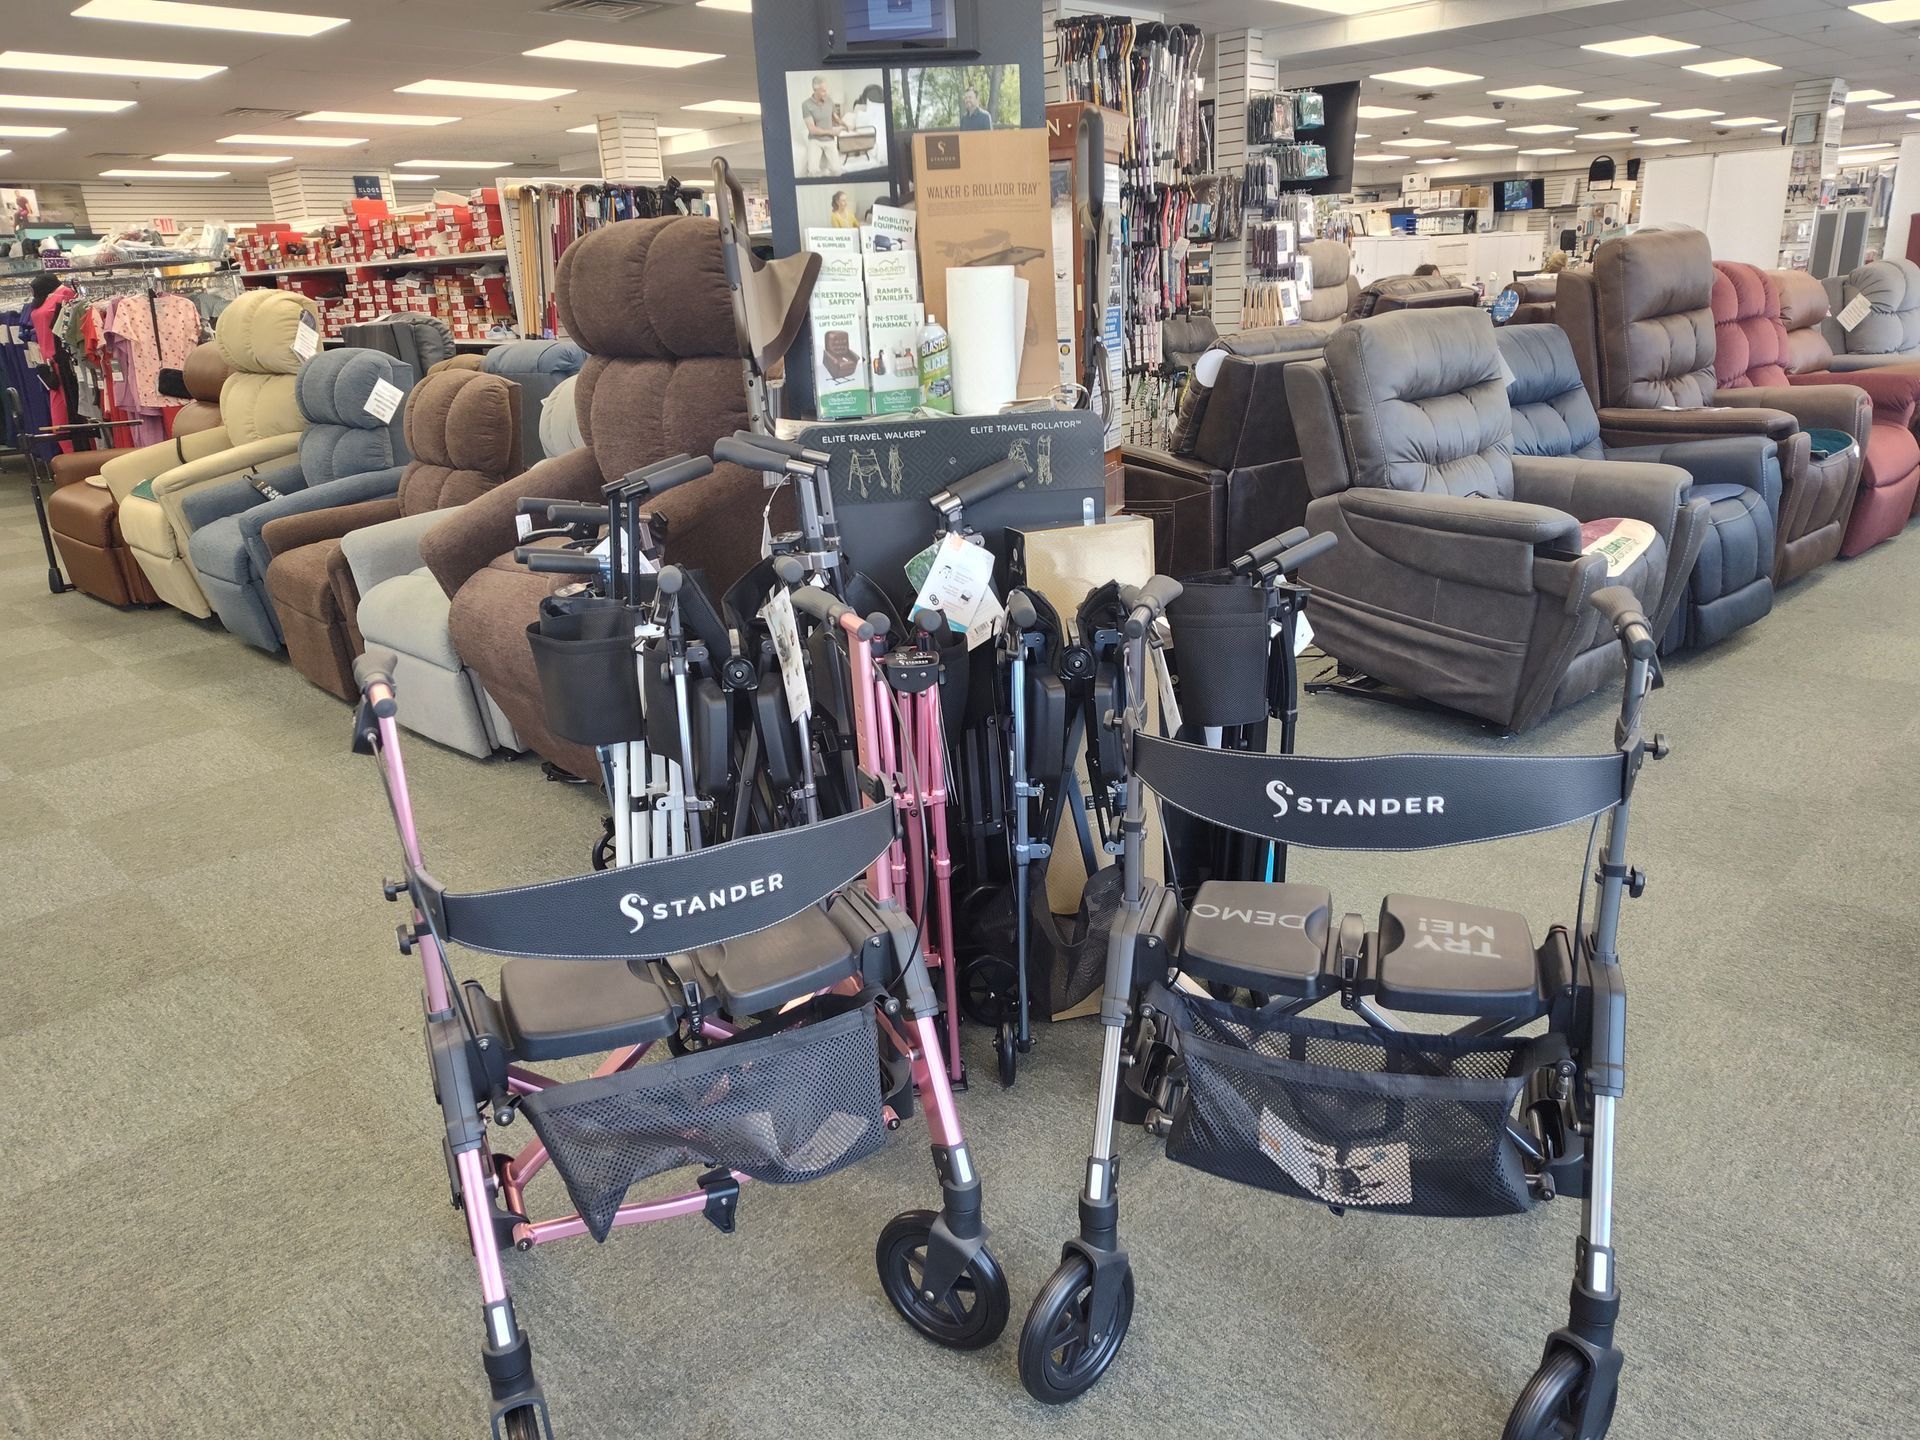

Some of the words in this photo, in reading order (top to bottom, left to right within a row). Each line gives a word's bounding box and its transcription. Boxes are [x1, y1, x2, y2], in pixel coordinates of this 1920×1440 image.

[927, 184, 961, 200] WALKER
[963, 185, 970, 197] &
[972, 182, 1015, 197] ROLLATOR
[877, 215, 910, 225] MOBILITY
[873, 222, 913, 233] EQUIPMENT
[874, 294, 913, 302] STAIRLIFTS
[875, 314, 908, 322] IN-STORE
[872, 321, 912, 329] PHARMACY
[970, 425, 994, 434] ELITE
[996, 423, 1029, 433] TRAVEL
[822, 435, 846, 444] ELITE
[848, 433, 882, 442] TRAVEL
[1297, 796, 1445, 817] STANDER
[652, 873, 784, 920] STANDER
[1191, 903, 1307, 929] DEMO
[1418, 917, 1495, 940] ME!
[1413, 934, 1502, 959] TRY
